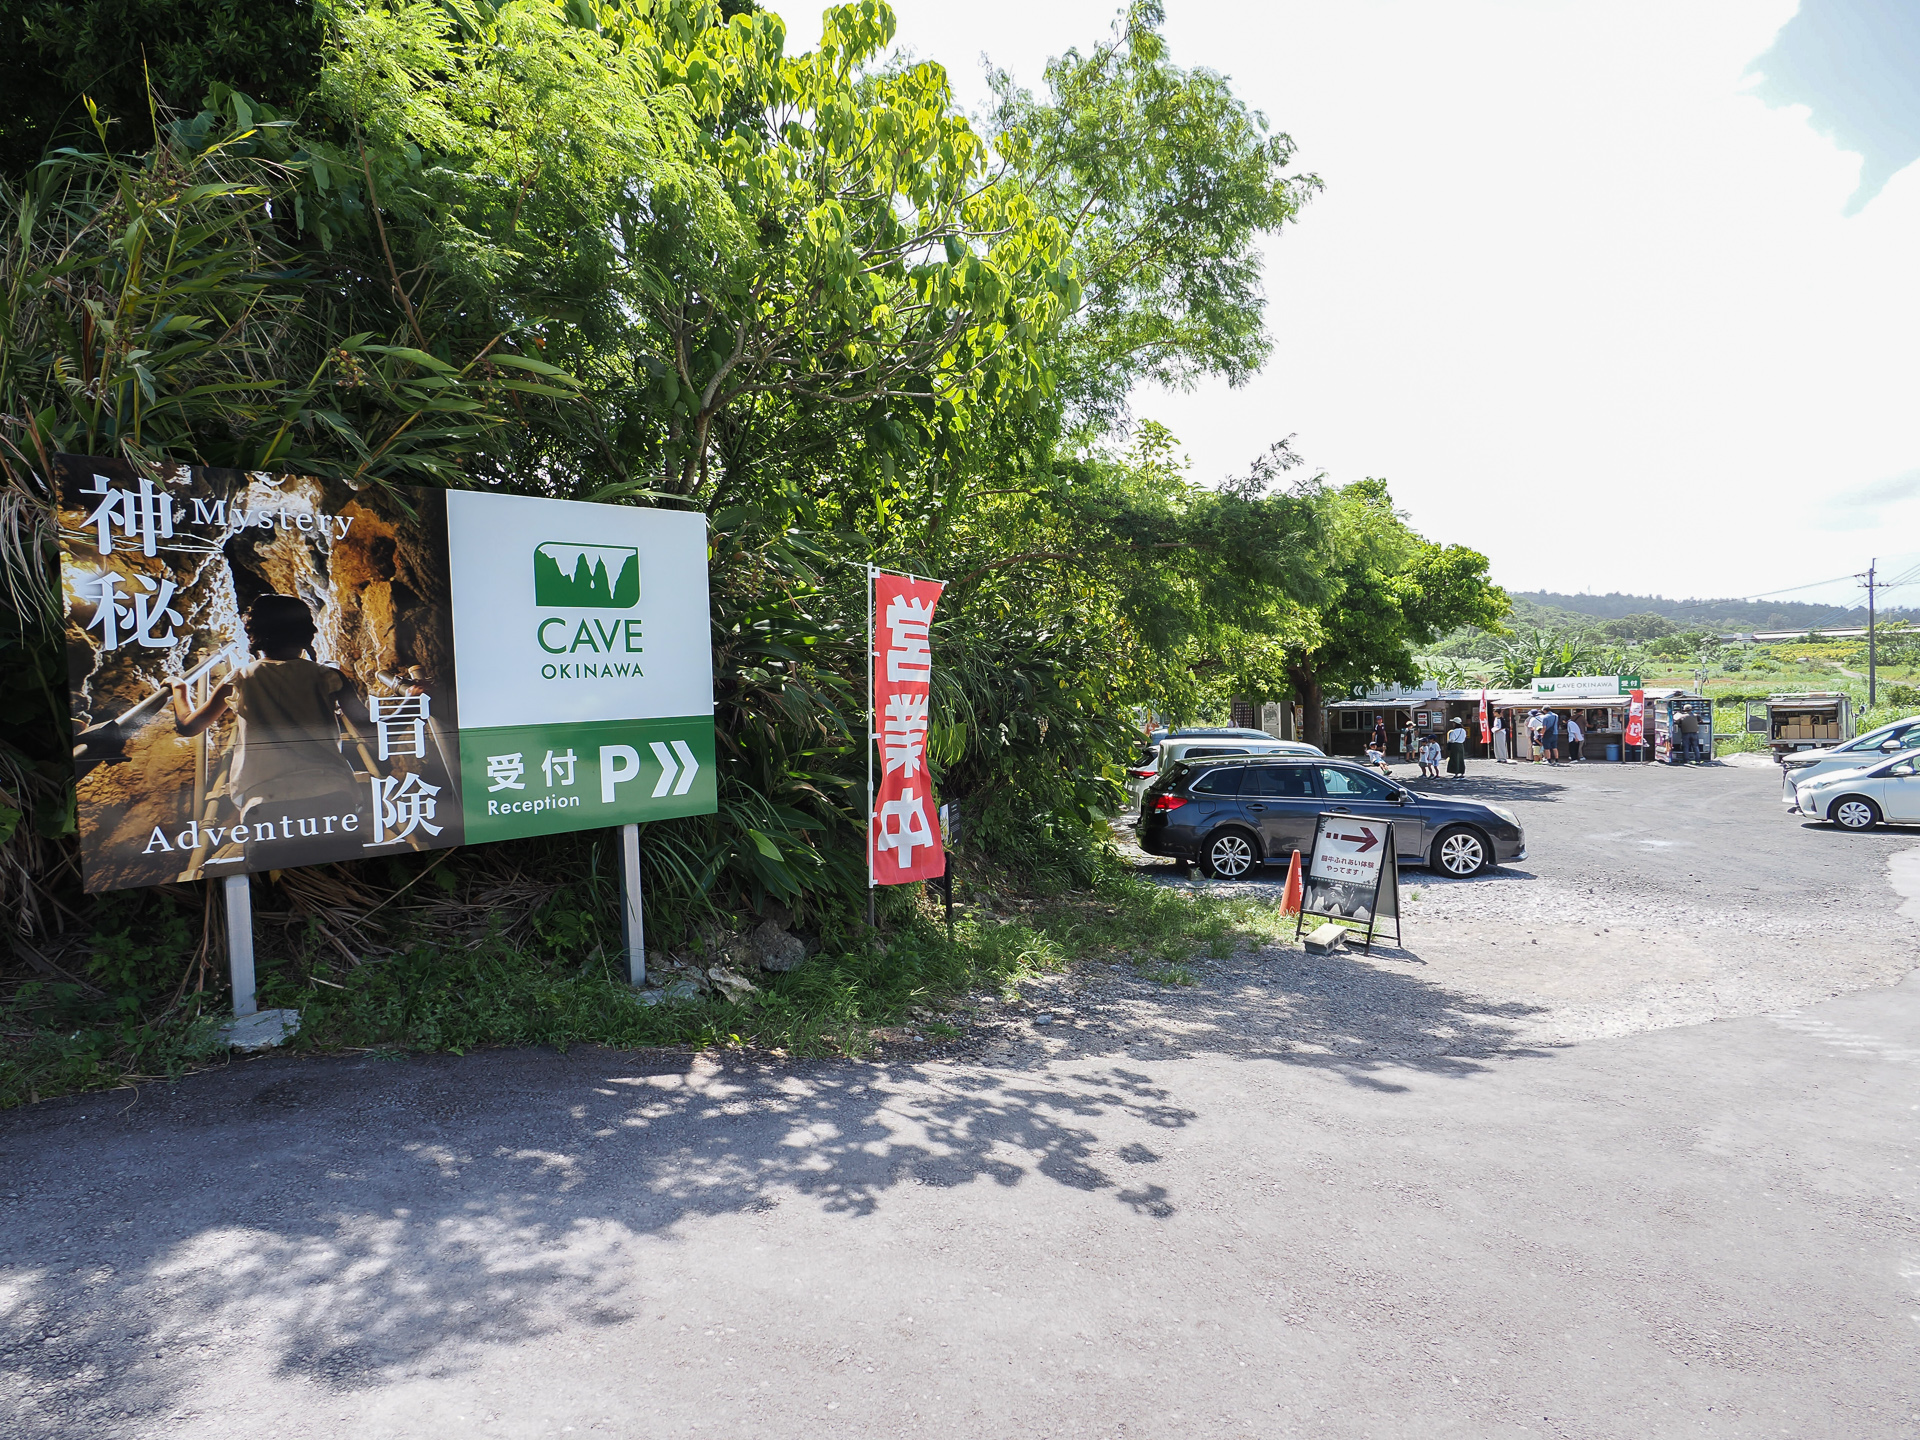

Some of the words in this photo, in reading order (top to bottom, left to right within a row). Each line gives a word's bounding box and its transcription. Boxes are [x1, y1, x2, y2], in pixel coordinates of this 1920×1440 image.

[190, 497, 354, 540] Mystery
[79, 474, 184, 651] 神秘
[537, 617, 644, 654] CAVE
[541, 662, 644, 680] OKINAWA
[878, 594, 934, 869] 営業中
[368, 693, 444, 844] 冒険
[487, 748, 577, 793] 受付
[599, 744, 640, 804] P
[488, 793, 580, 816] Reception
[142, 813, 359, 854] Adventure
